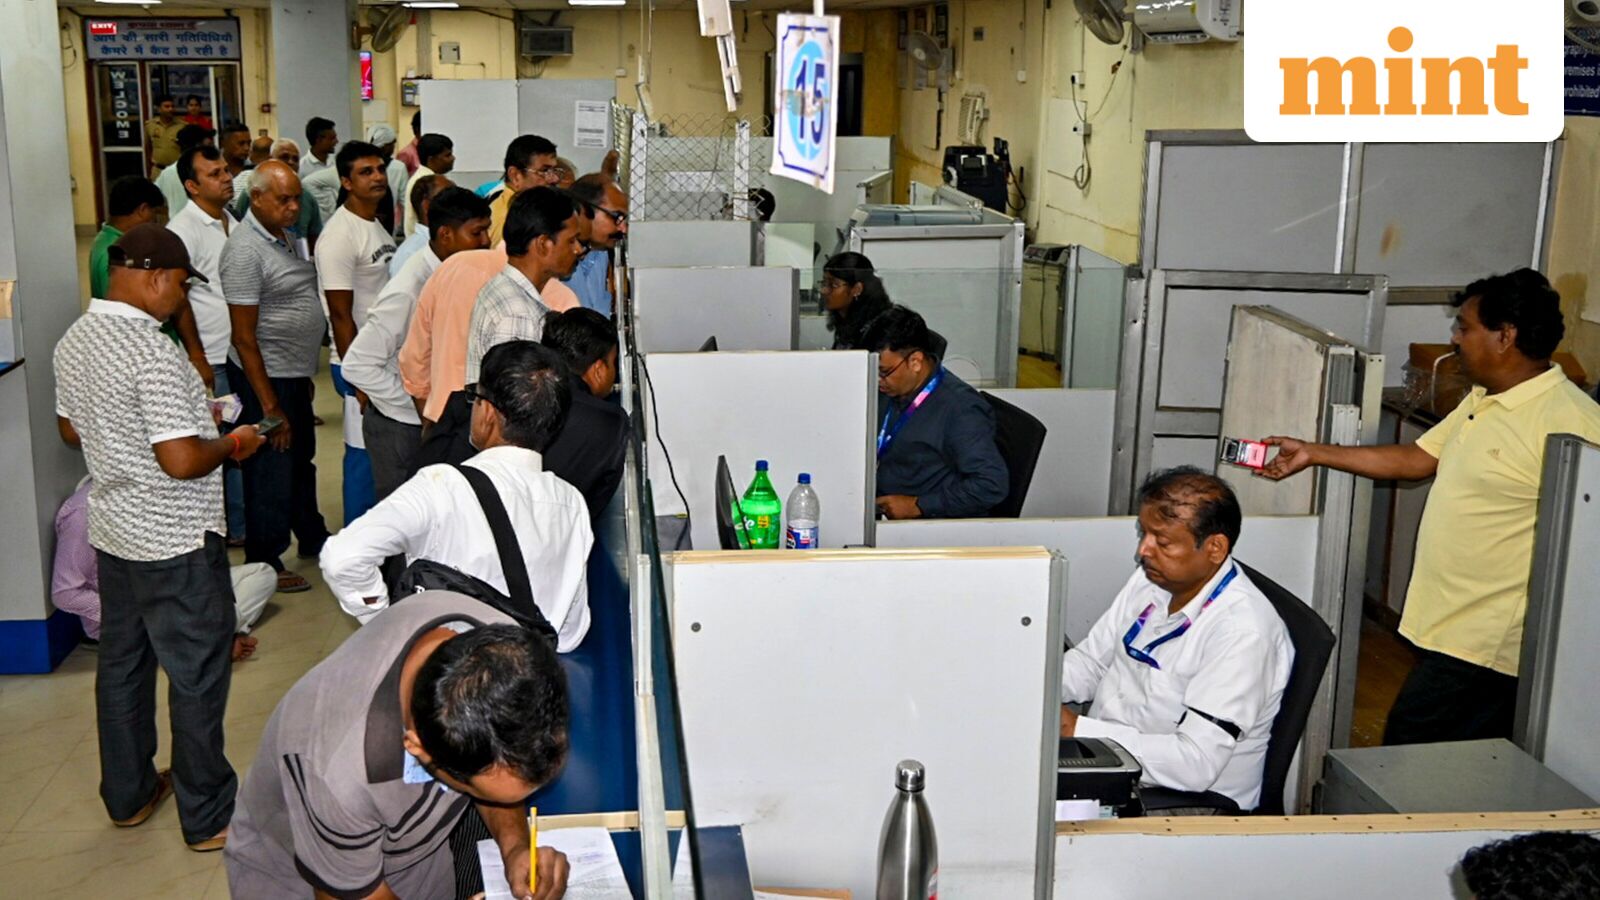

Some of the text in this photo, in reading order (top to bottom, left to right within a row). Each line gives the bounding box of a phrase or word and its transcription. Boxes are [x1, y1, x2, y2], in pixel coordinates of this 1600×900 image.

[1564, 64, 1595, 76] remises
[1564, 85, 1600, 98] rohibited
[795, 59, 826, 145] 15
